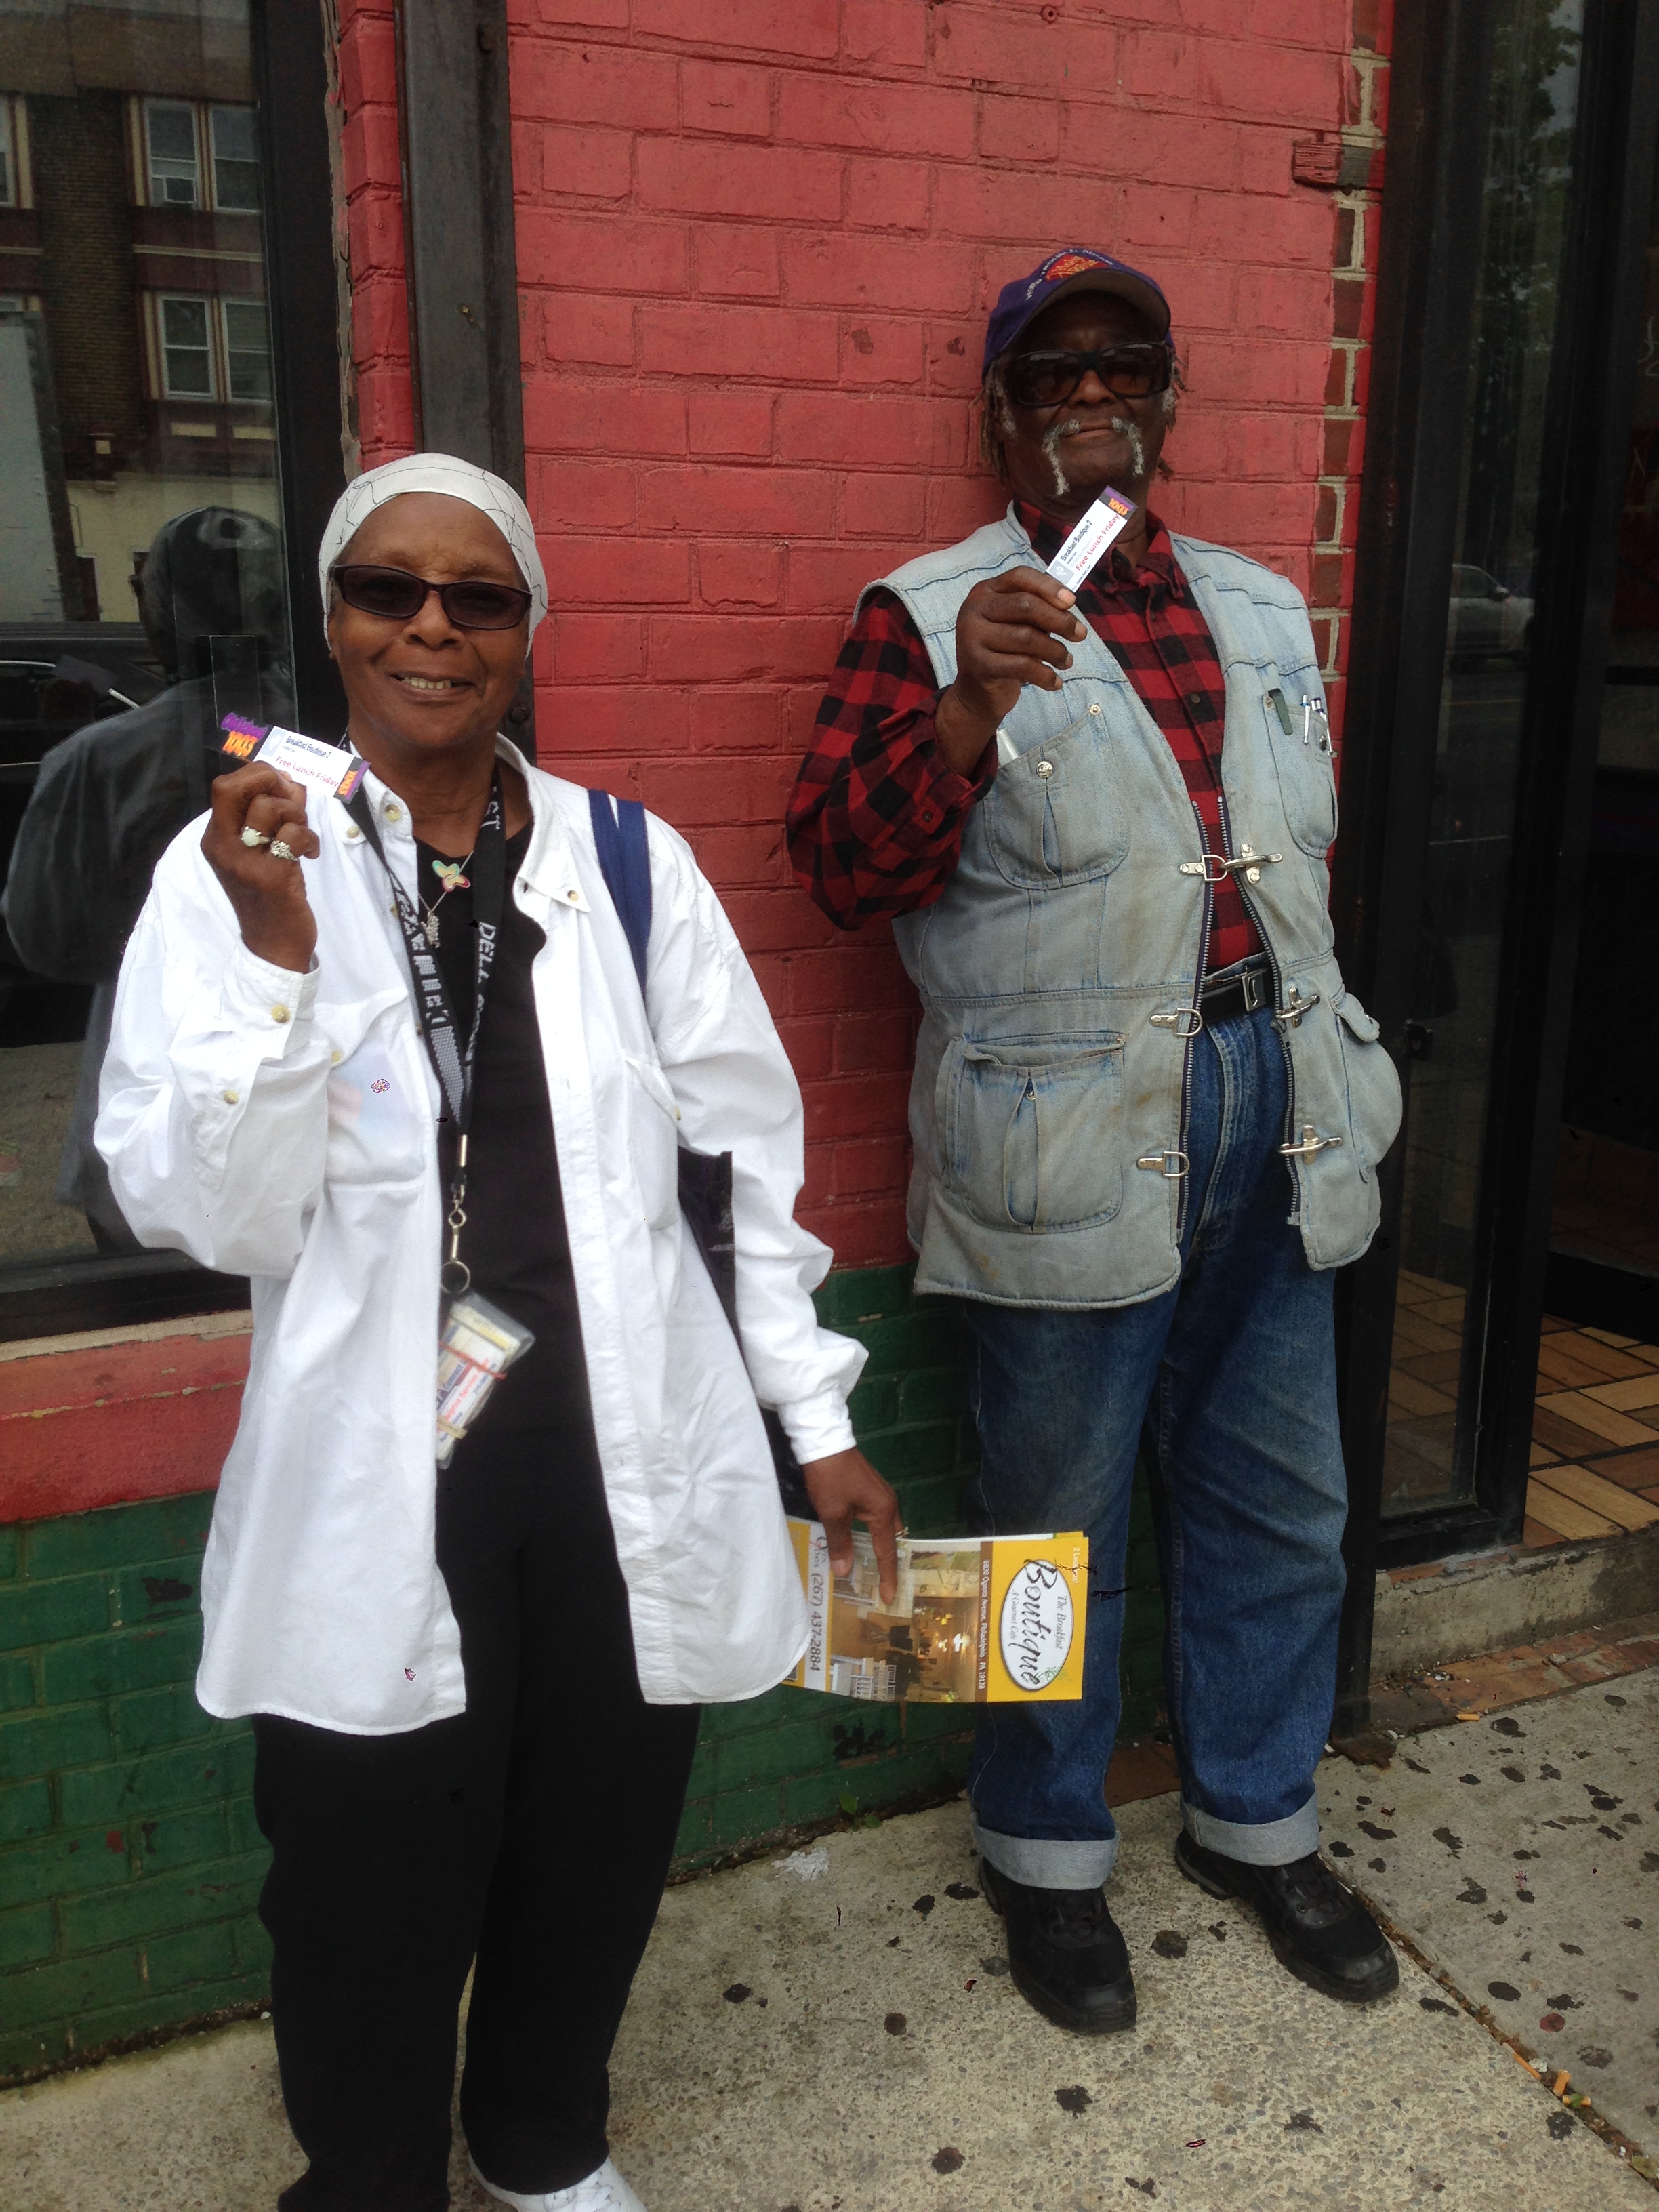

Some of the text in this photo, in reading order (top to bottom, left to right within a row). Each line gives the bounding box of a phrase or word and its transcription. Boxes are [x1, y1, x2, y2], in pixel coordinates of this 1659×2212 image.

[1060, 540, 1078, 561] Breakfast
[1073, 523, 1091, 543] Boutique
[1075, 555, 1089, 571] Free
[1086, 534, 1104, 556] Lunch
[1101, 513, 1121, 536] Friday
[285, 735, 308, 751] Breakfast
[306, 743, 327, 760] Boutique
[275, 756, 340, 789] Free Lunch Friday
[981, 1577, 989, 1597] Ogontz
[810, 1573, 824, 1671] (267) 437-2884
[1008, 1557, 1057, 1685] Boutique
[1010, 1598, 1019, 1624] Gourmet
[1054, 1596, 1067, 1650] The Breakfast
